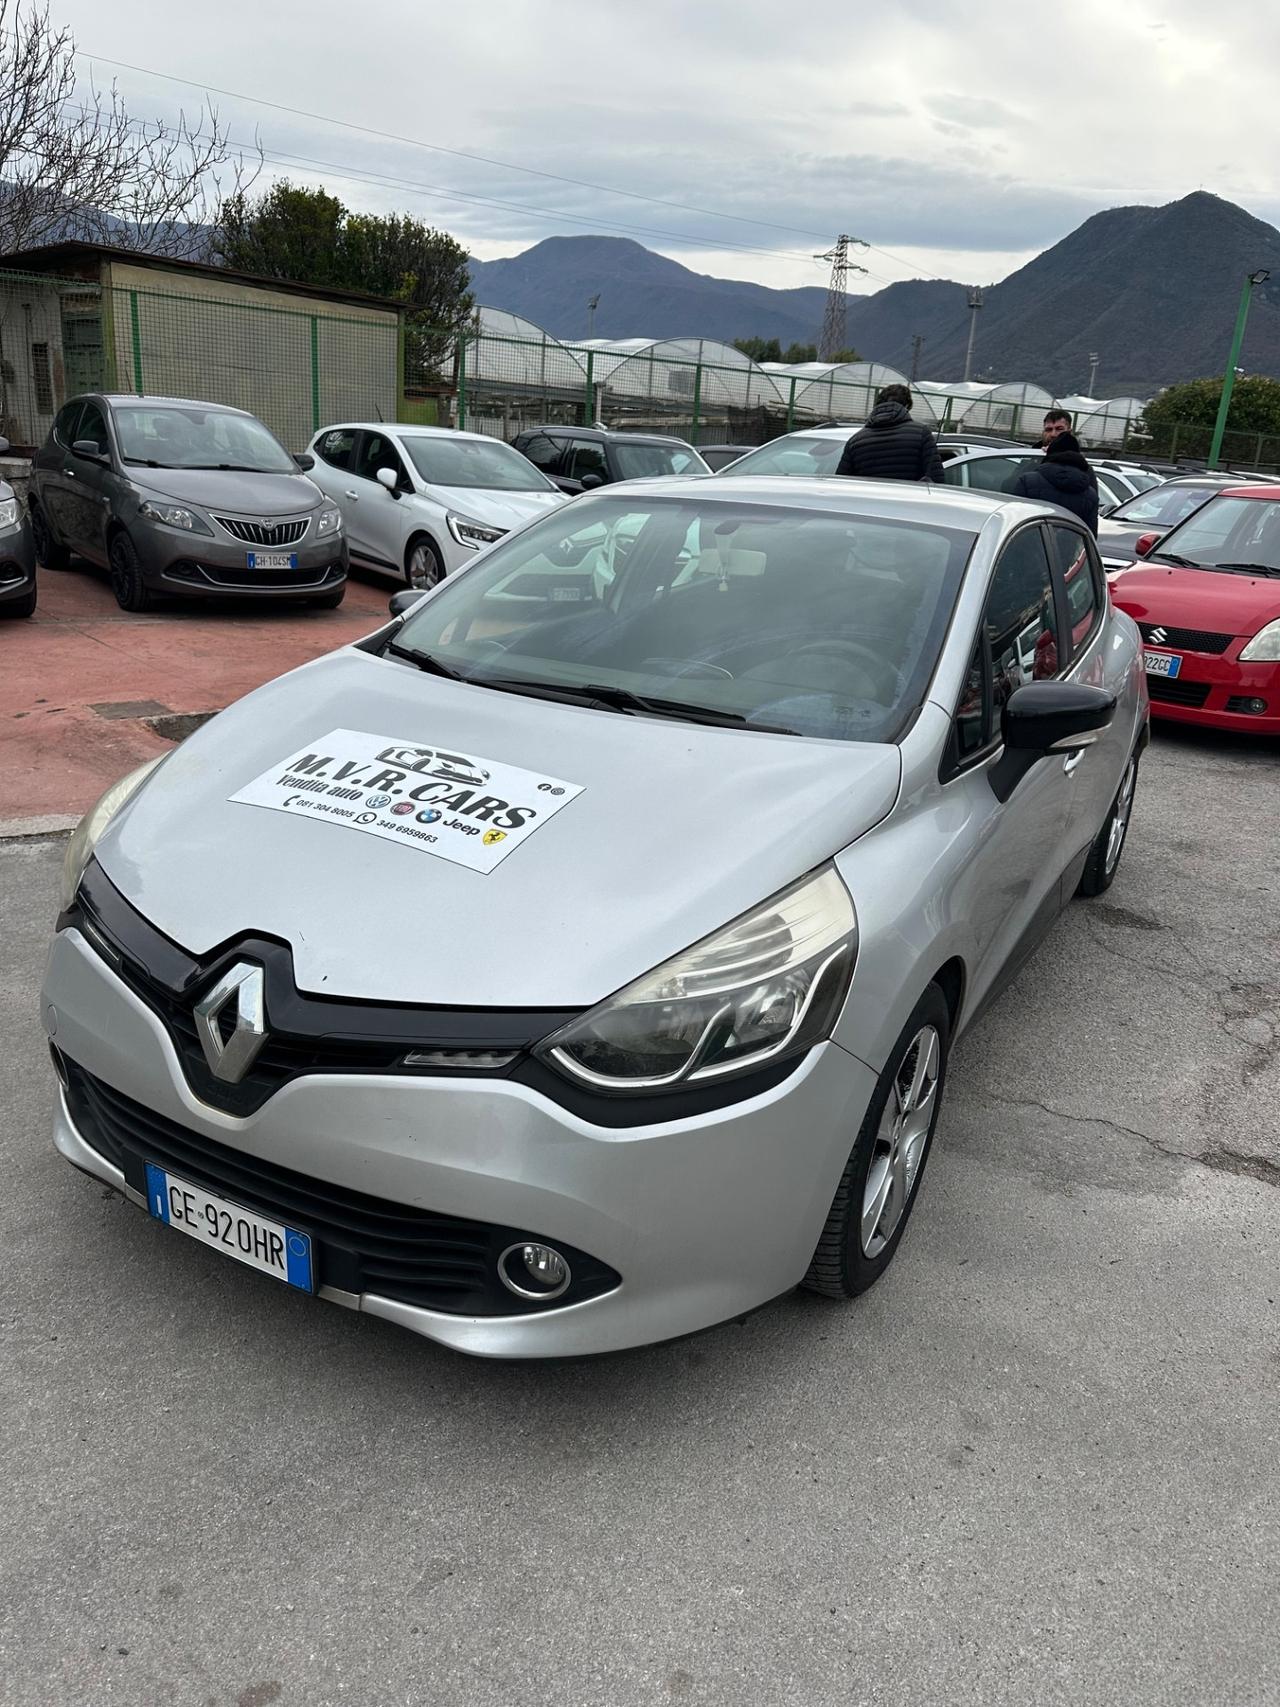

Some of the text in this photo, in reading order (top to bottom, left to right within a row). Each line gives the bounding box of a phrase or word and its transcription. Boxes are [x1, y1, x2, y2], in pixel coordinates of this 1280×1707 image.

[276, 774, 364, 801] Vendita auto
[296, 799, 355, 817] 081 304 8005
[376, 820, 439, 843] 349 6959863
[442, 818, 481, 836] Jeep
